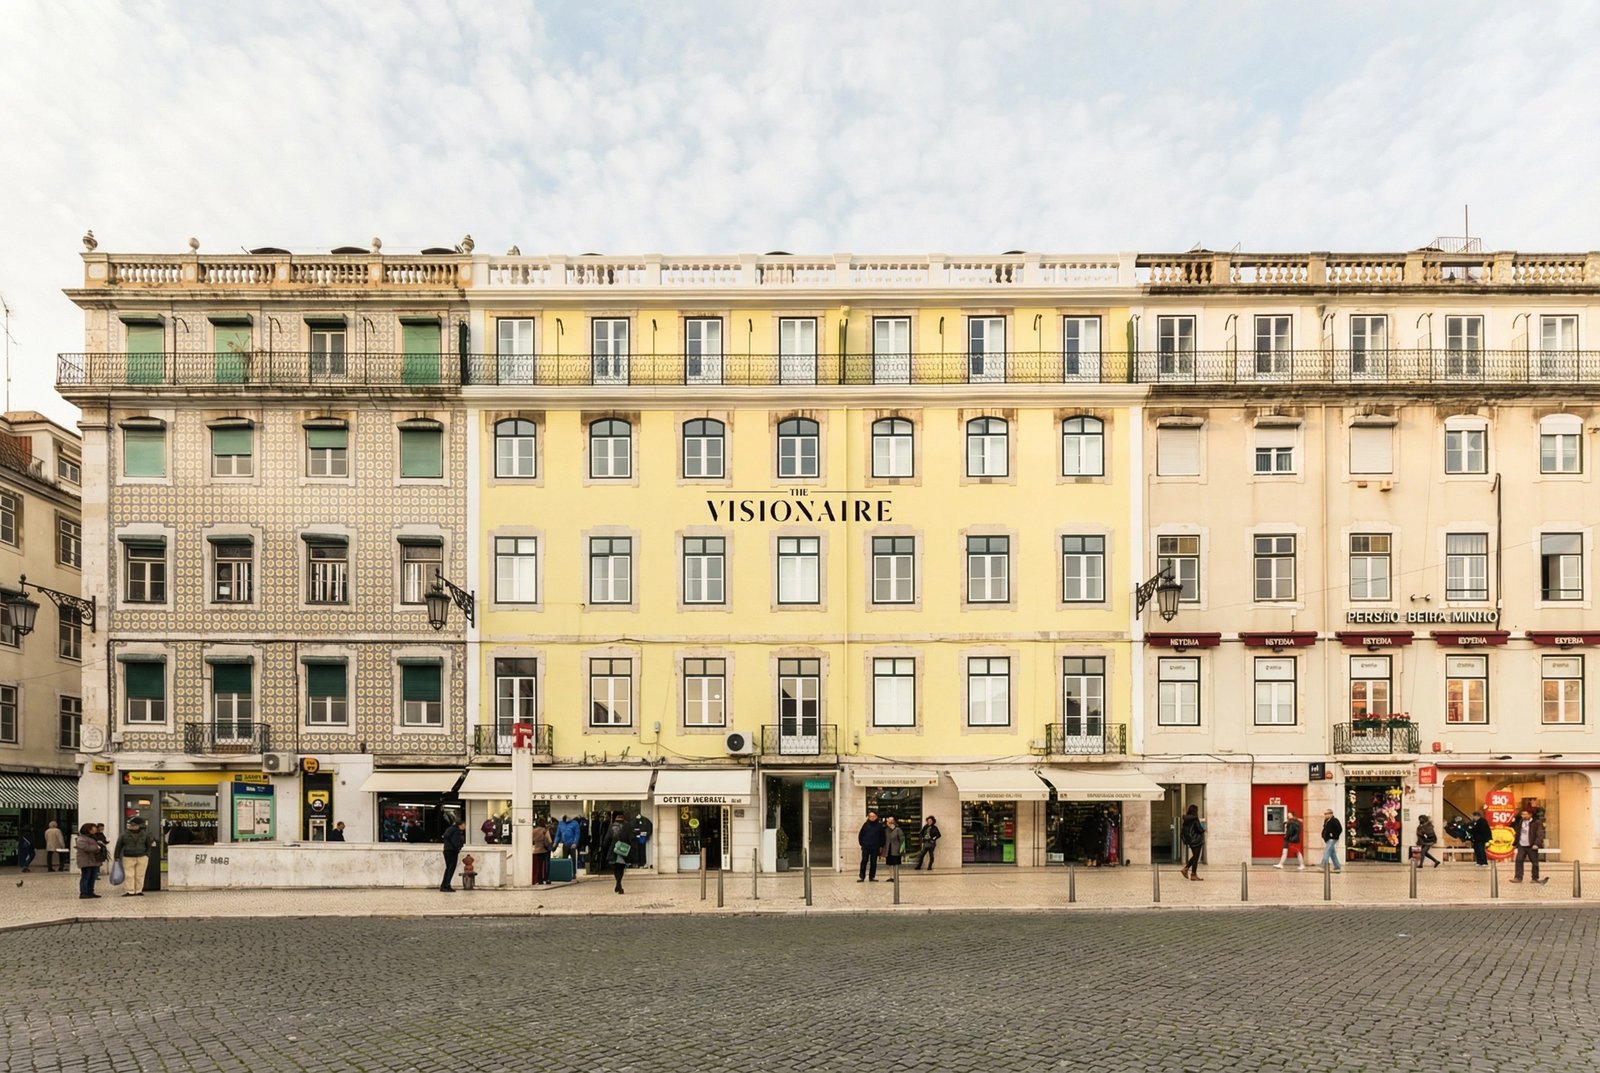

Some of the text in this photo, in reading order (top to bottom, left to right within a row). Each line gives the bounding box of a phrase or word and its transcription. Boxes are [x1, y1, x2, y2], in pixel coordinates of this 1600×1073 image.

[790, 488, 809, 496] THE
[706, 500, 893, 522] VISIONAIRE
[1492, 812, 1516, 823] 50%
